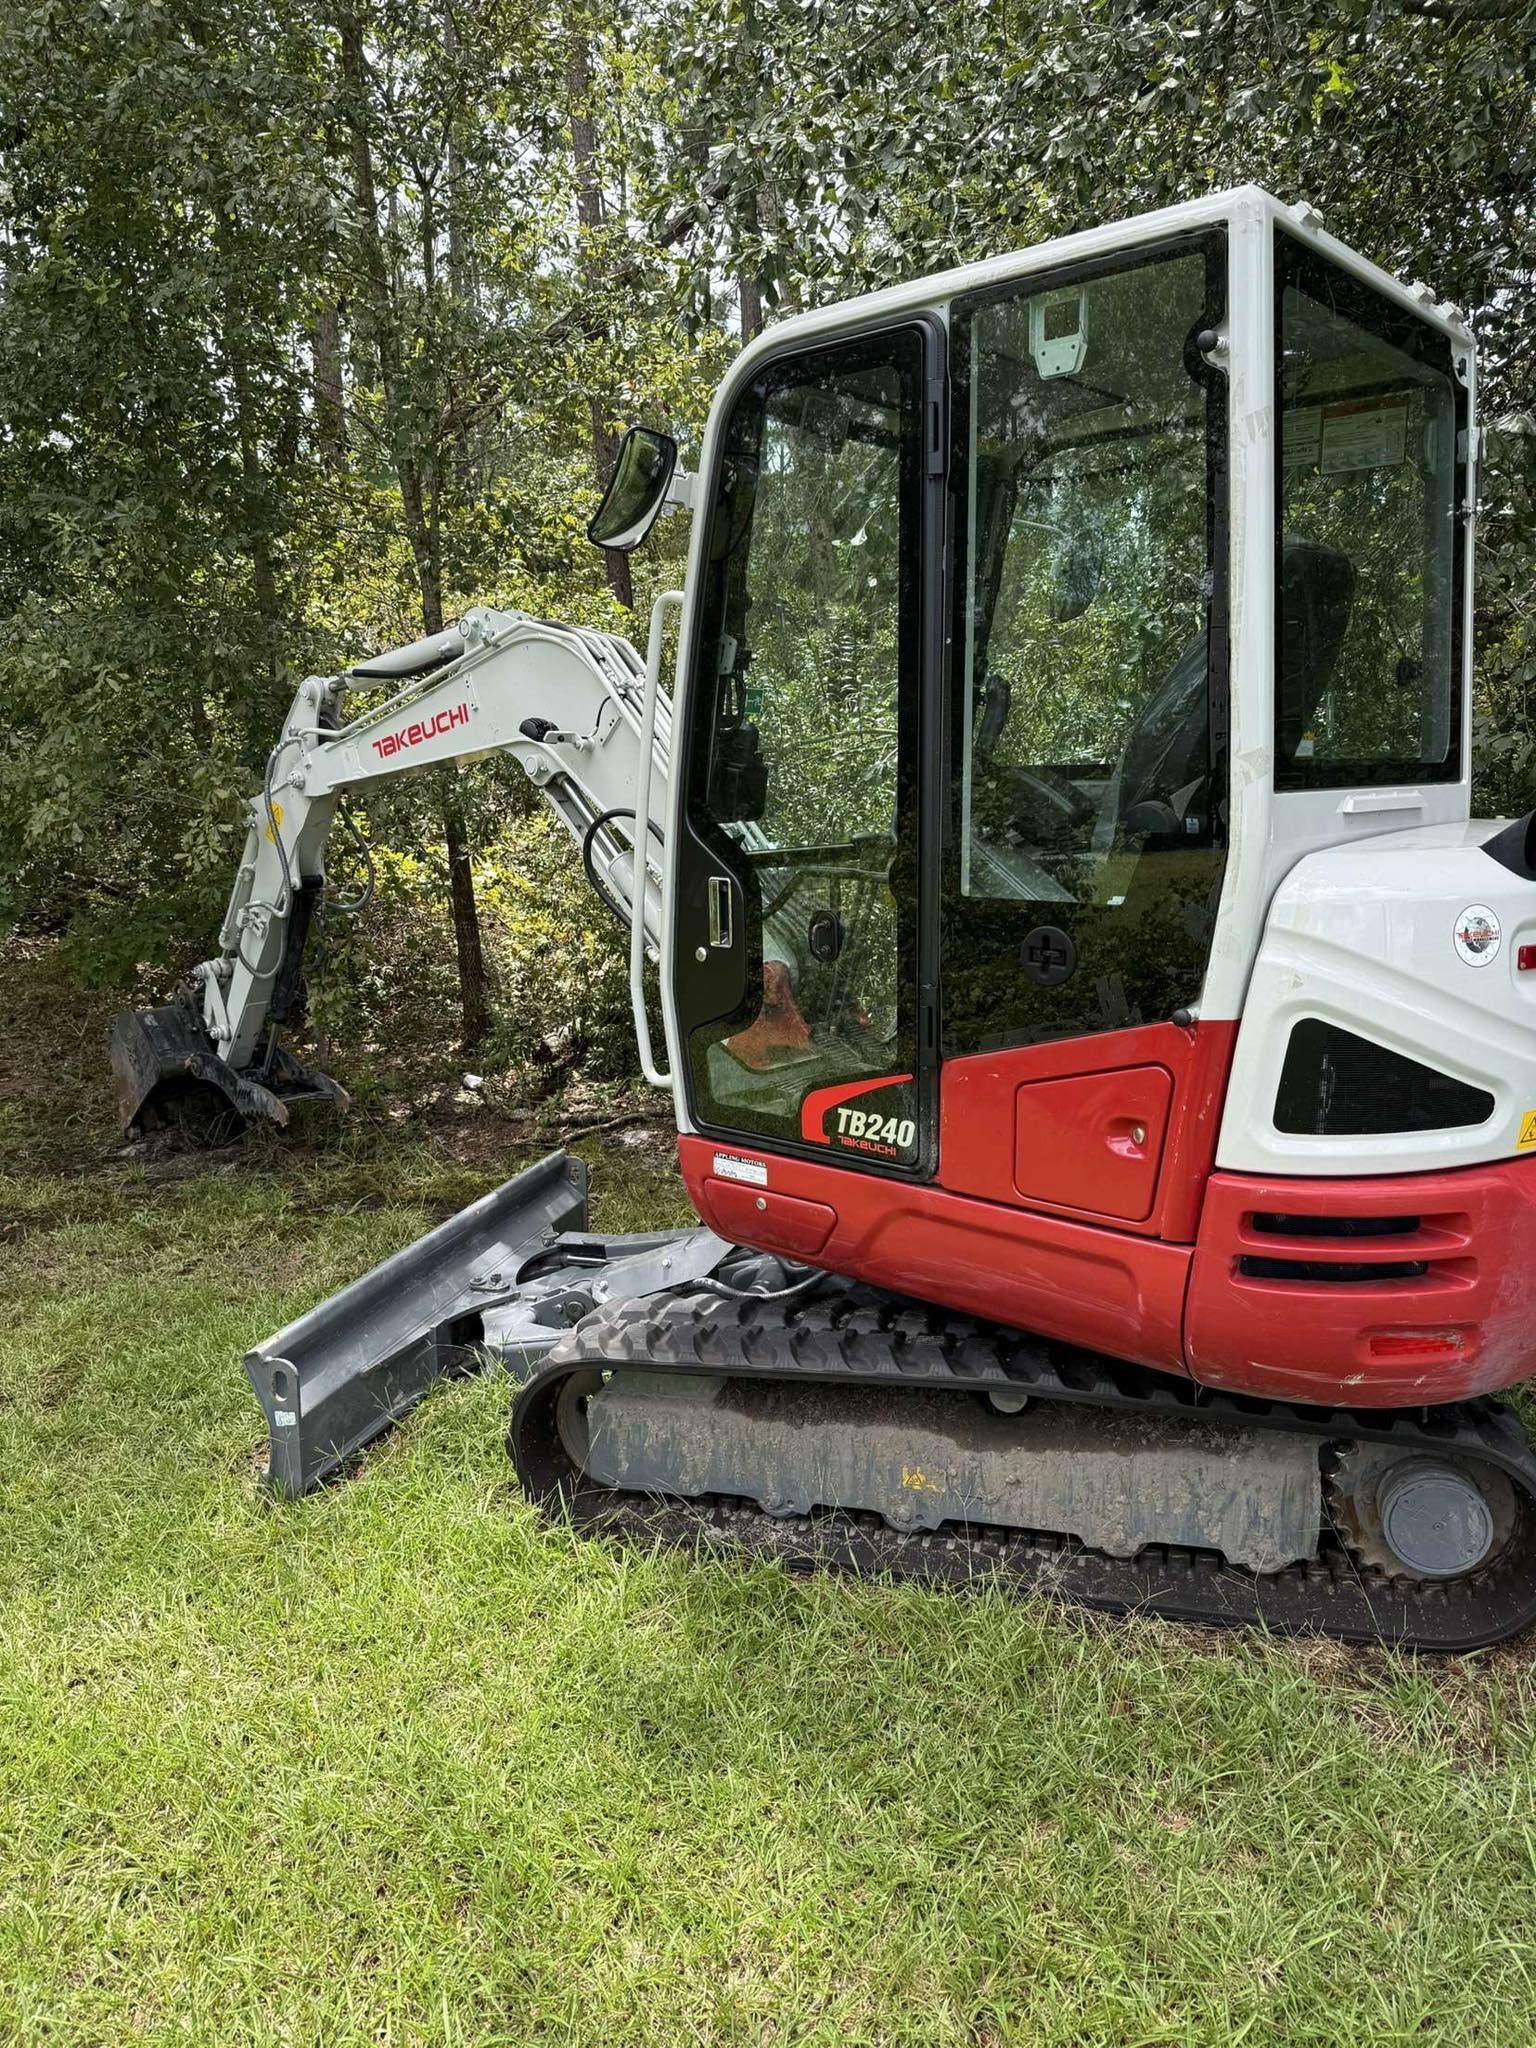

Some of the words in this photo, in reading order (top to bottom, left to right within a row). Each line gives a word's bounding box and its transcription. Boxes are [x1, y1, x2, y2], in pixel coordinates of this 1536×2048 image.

[837, 1107, 916, 1148] TB240
[714, 1151, 740, 1162] APPLING
[741, 1157, 766, 1167] MOTORS
